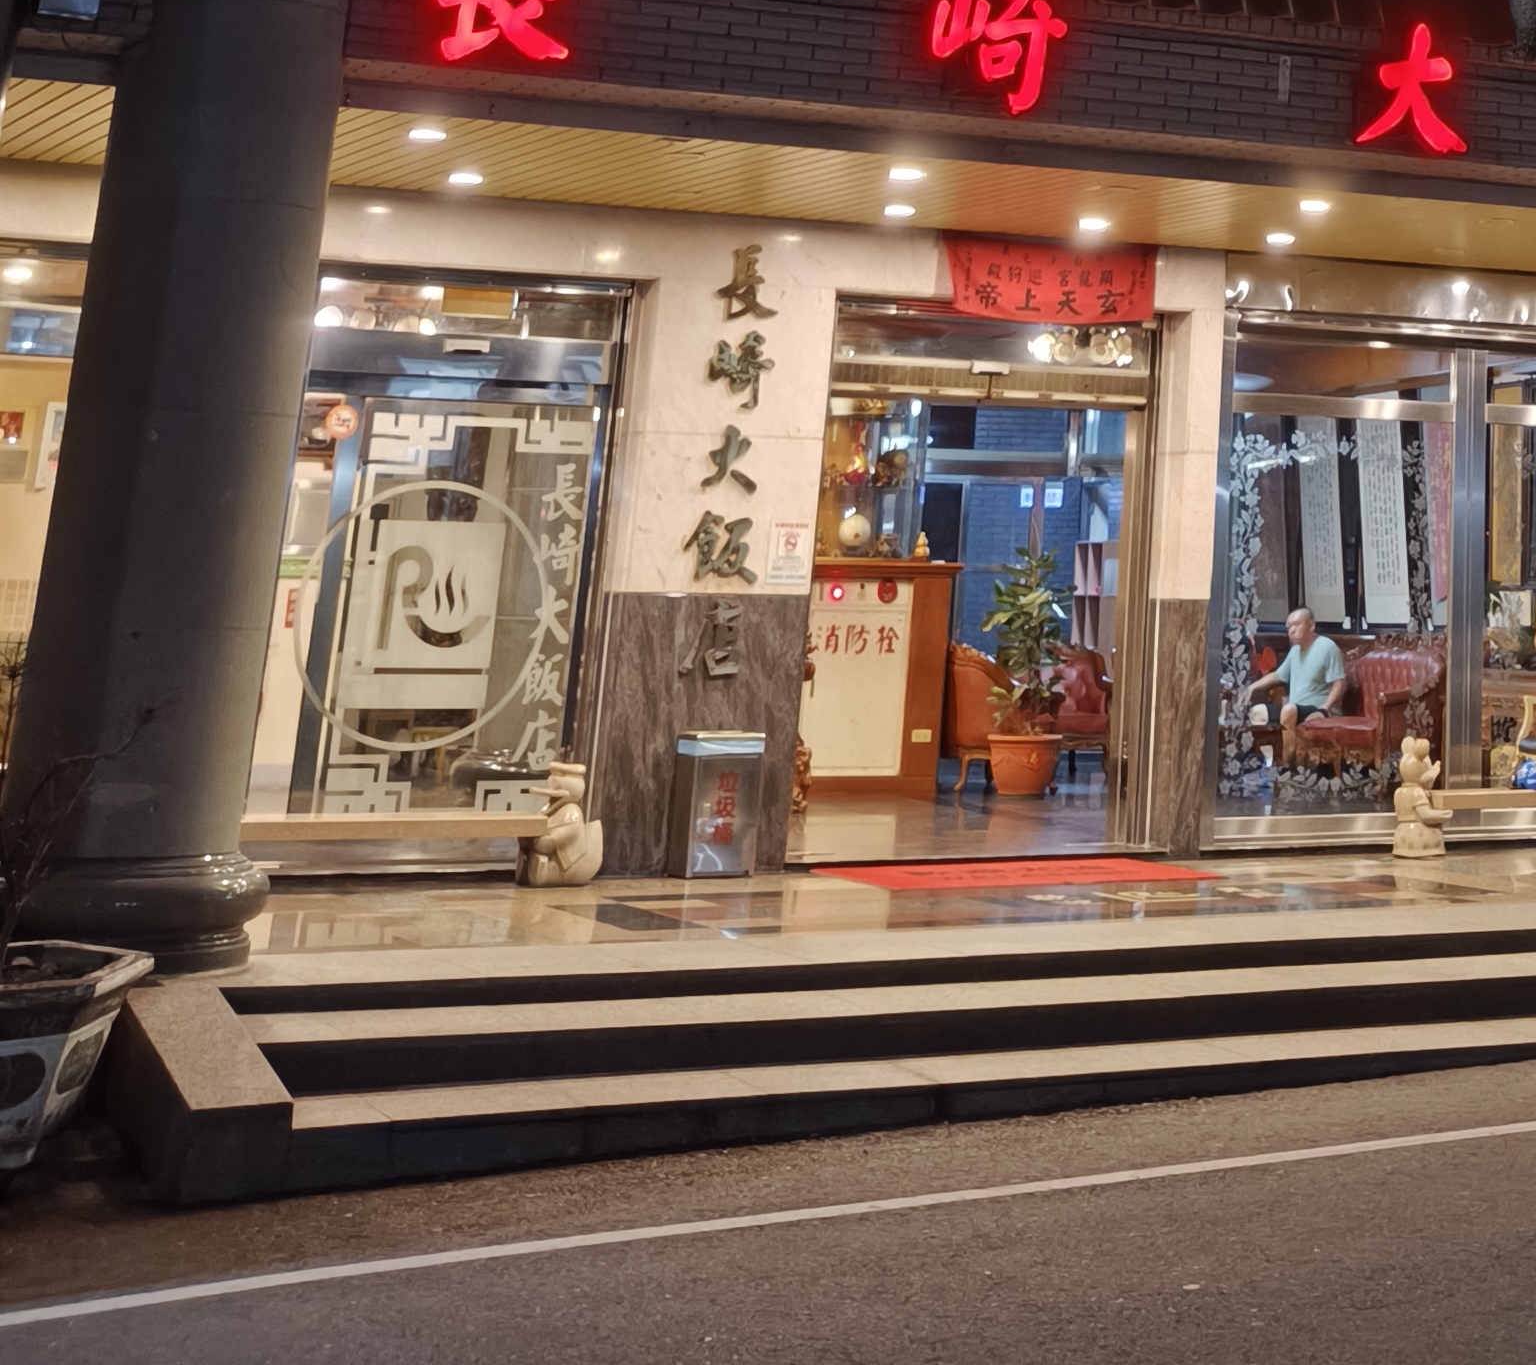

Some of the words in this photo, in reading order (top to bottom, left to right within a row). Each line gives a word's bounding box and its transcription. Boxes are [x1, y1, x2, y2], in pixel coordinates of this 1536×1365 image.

[681, 243, 779, 677] 長崎大飯店
[511, 462, 584, 770] 長崎大飯店
[816, 624, 899, 655] 消防栓
[712, 772, 740, 846] 垃圾桶
